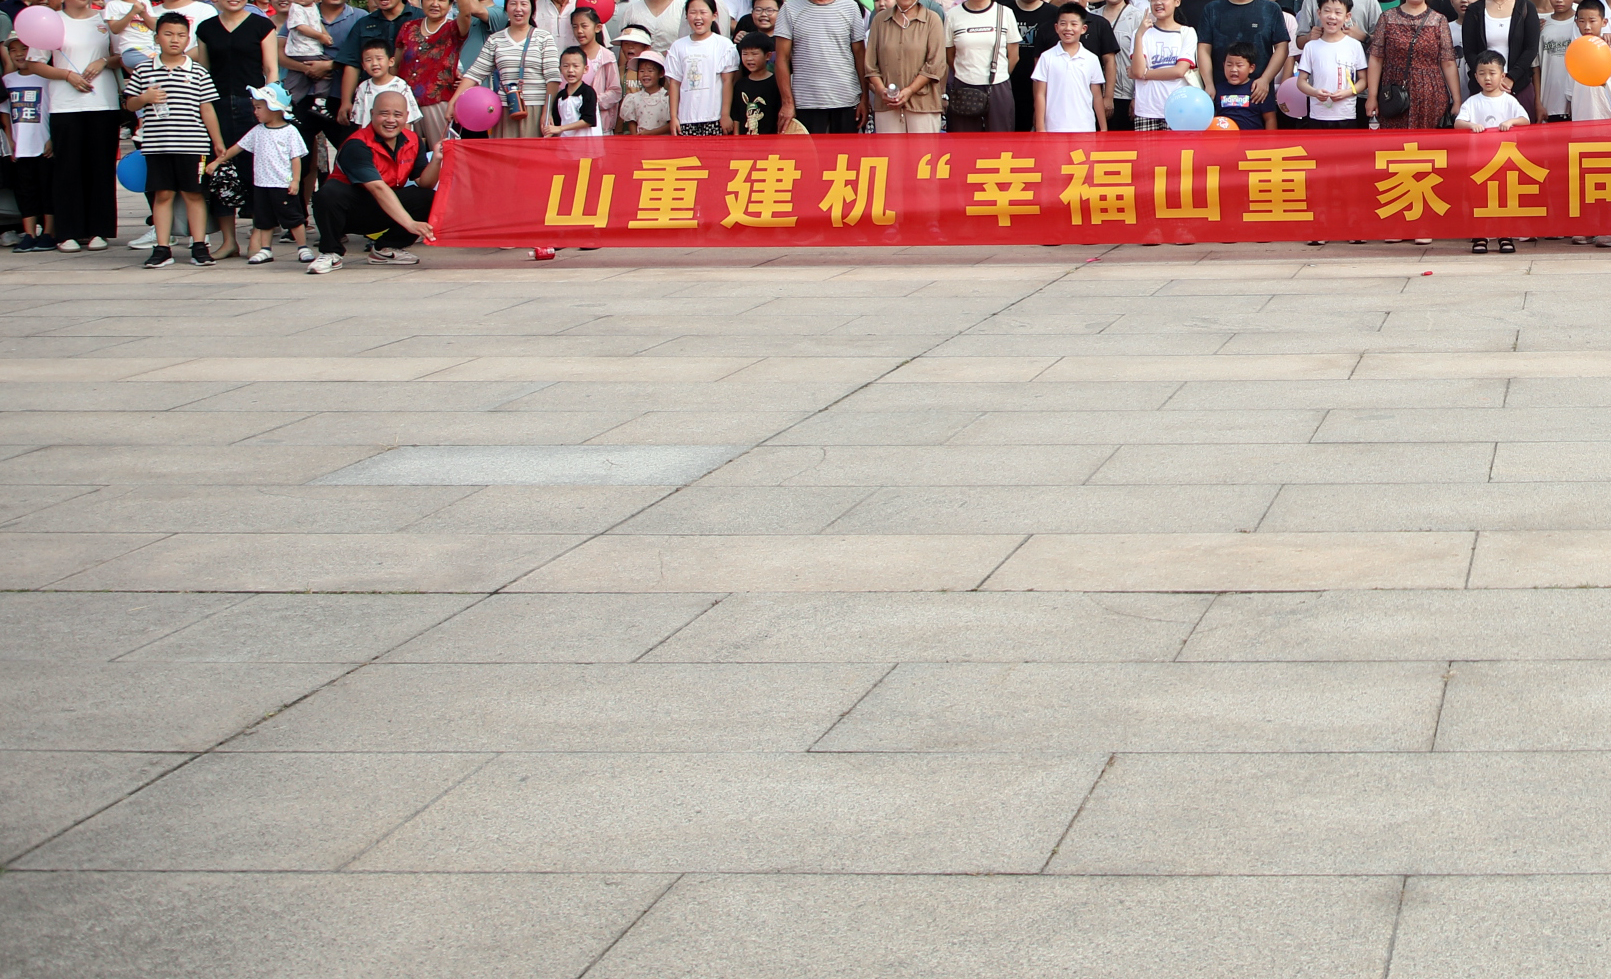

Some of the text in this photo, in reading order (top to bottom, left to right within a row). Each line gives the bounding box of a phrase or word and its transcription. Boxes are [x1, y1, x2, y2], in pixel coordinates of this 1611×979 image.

[544, 147, 1317, 229] 山重建机“幸福山重
